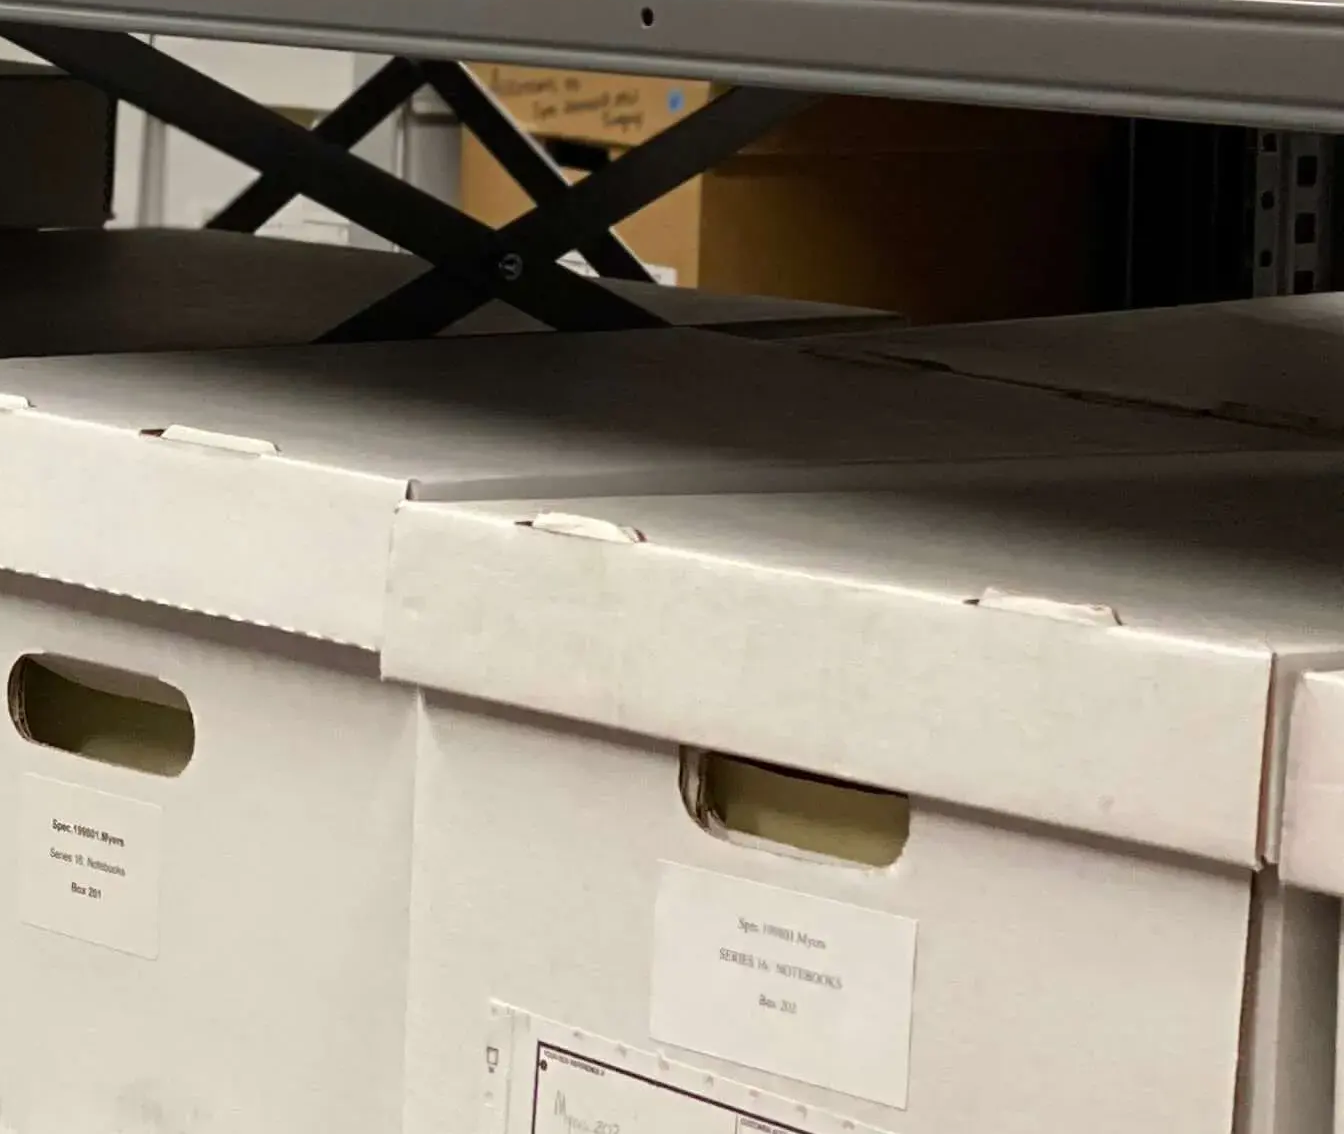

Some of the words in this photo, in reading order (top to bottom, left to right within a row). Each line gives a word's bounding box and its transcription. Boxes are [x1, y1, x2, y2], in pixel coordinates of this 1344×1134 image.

[50, 847, 73, 862] Series
[72, 882, 86, 895] Box
[88, 886, 102, 899] 201
[719, 947, 754, 968] SERIES
[776, 963, 843, 990] NOTEBOOKS
